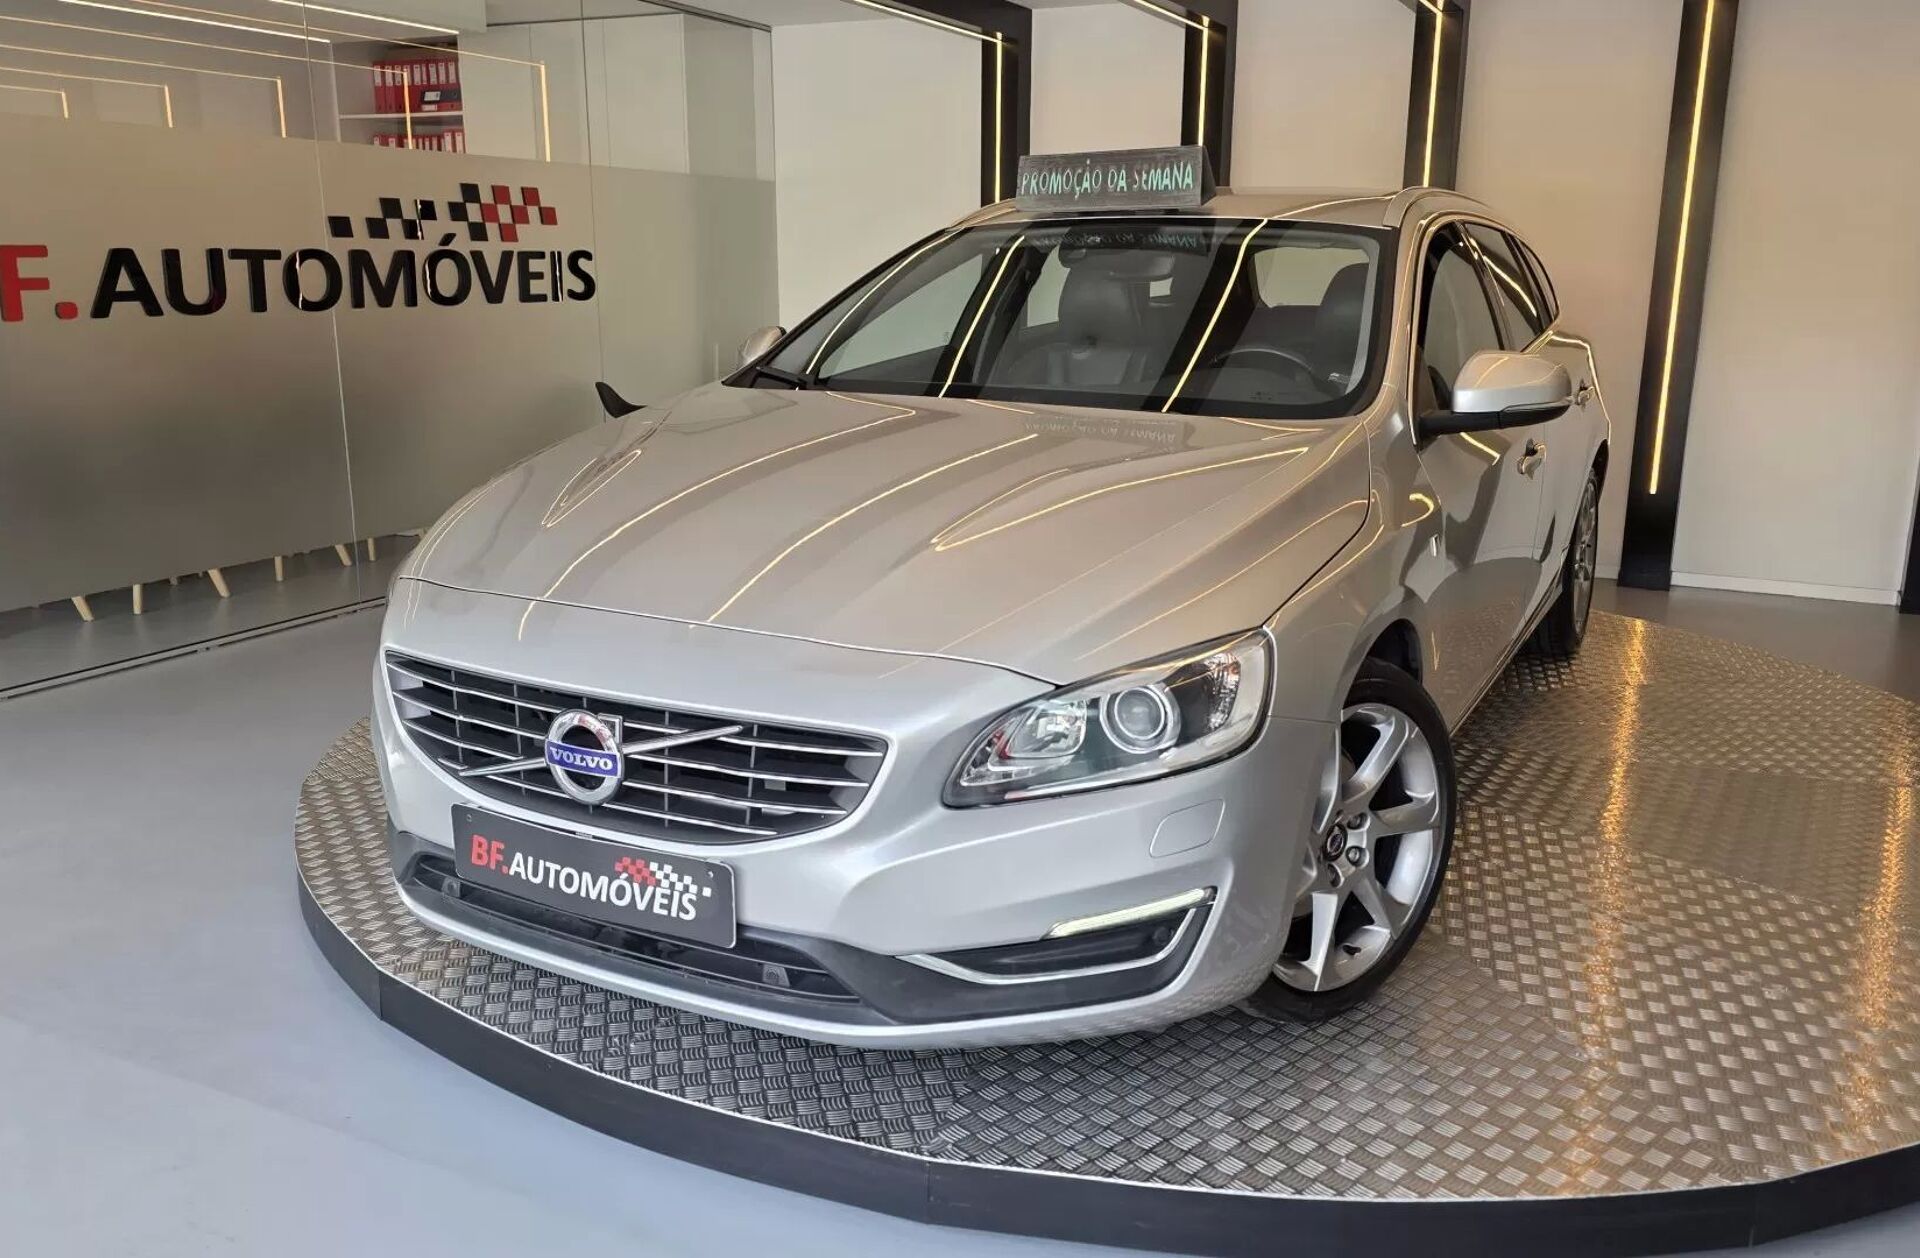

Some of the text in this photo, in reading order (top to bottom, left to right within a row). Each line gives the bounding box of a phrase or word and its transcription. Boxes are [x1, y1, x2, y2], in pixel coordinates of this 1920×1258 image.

[1107, 167, 1128, 192] DA
[1132, 161, 1193, 192] SEMANA
[549, 746, 614, 771] VOLVO
